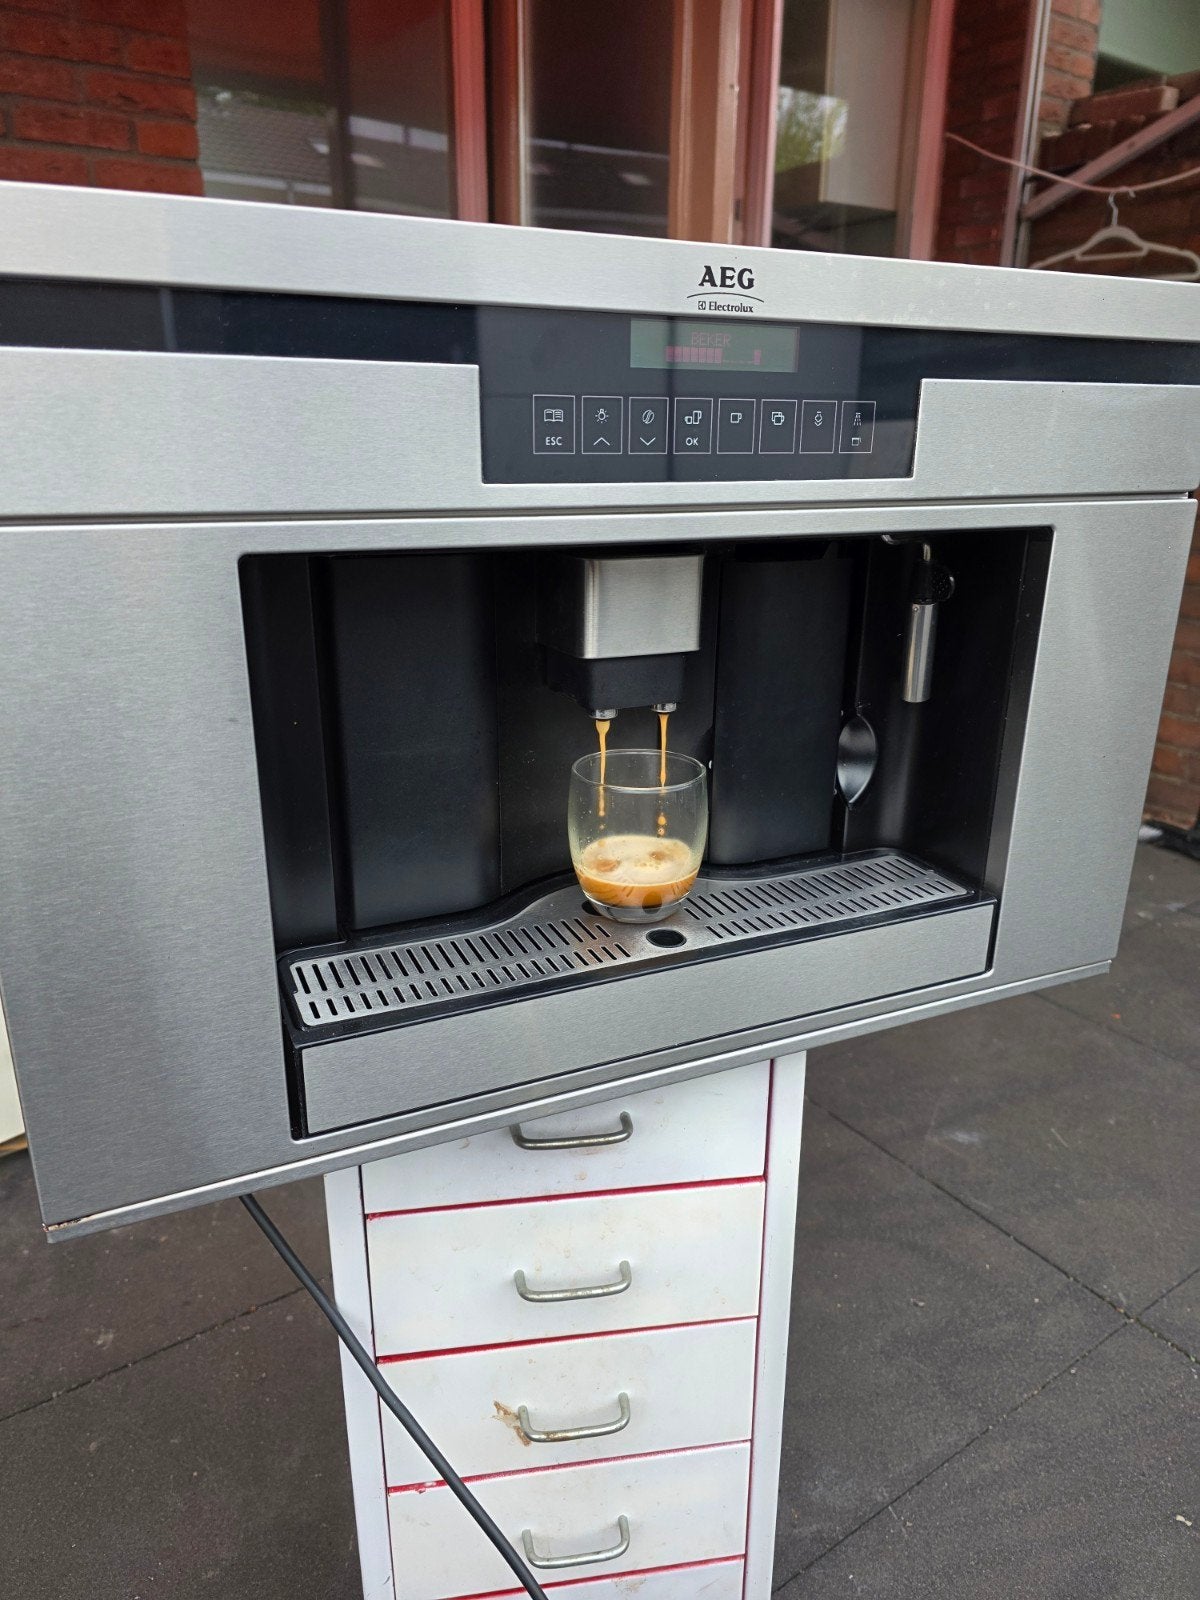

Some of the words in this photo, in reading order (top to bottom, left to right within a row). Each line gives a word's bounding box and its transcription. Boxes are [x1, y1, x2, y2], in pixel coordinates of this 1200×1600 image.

[699, 265, 755, 290] AEG
[708, 301, 754, 313] Electrolux
[691, 331, 731, 347] BEKER
[545, 436, 563, 446] ESC
[685, 437, 699, 446] OK
